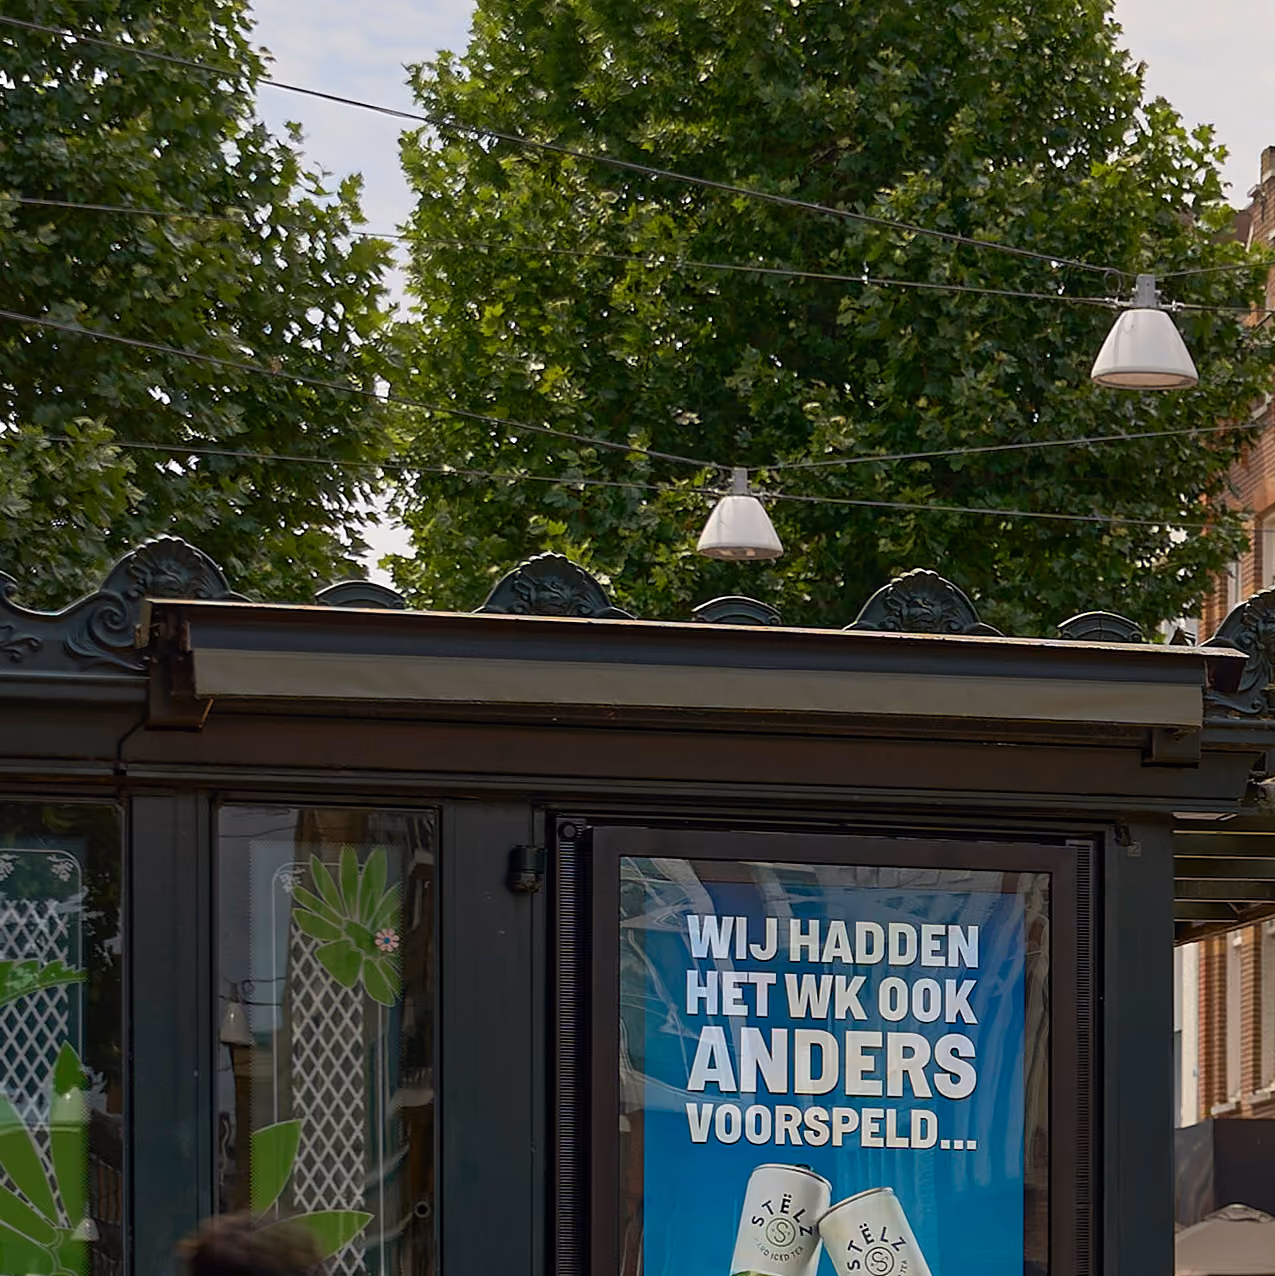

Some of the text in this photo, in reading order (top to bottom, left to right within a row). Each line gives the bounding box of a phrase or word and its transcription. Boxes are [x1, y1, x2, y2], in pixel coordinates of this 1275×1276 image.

[686, 914, 979, 969] WIJ HADDEN
[685, 969, 979, 1025] HET WK OOK
[686, 1026, 978, 1100] ANDERS
[685, 1102, 978, 1151] VOORSPELD...
[847, 1223, 907, 1271] STËLZ
